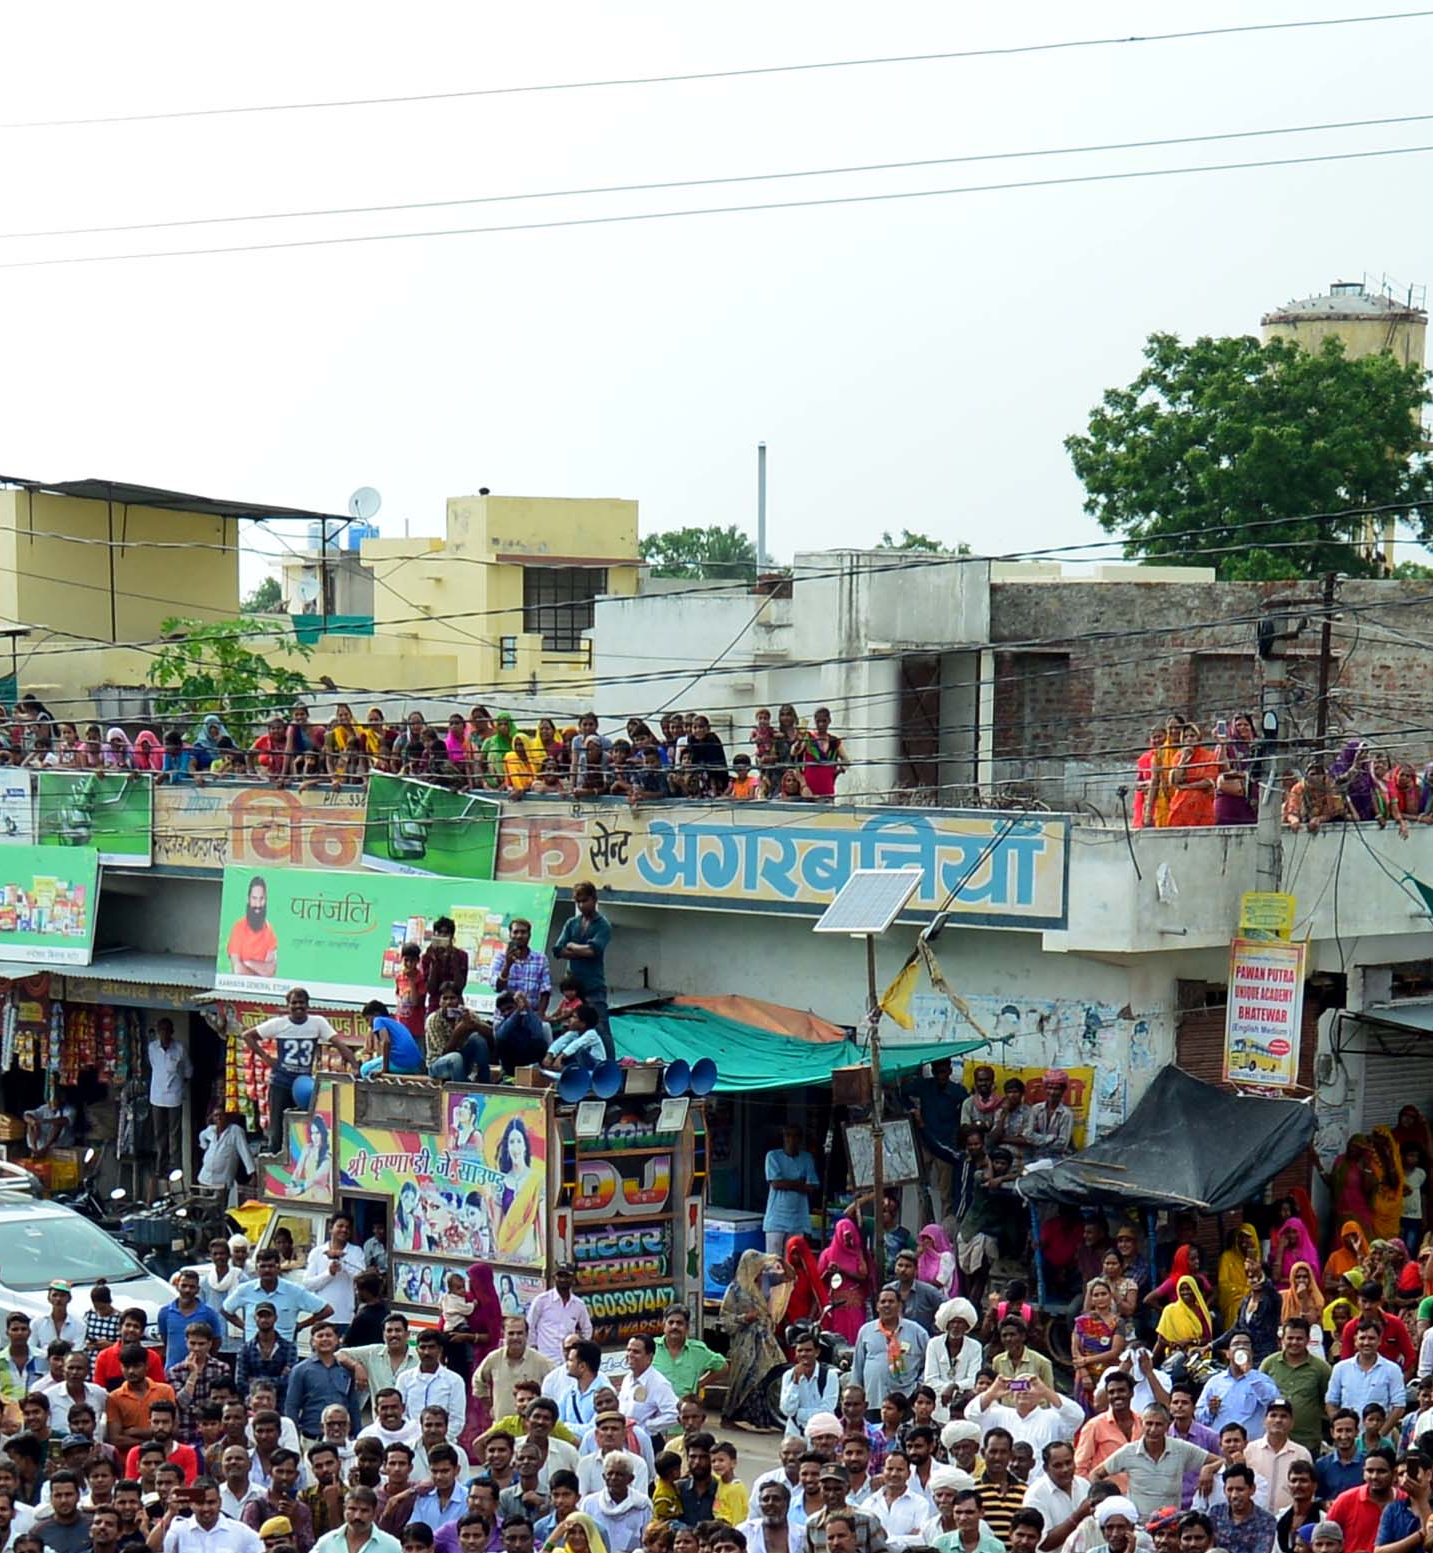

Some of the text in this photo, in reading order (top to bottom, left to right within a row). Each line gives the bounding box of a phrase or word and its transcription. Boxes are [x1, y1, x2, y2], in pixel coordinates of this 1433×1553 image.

[590, 822, 630, 872] सेन्ट
[290, 890, 373, 924] पतंजलि
[1236, 966, 1295, 983] PAWAN PUTRA
[1235, 984, 1293, 1003] UNIQUE ACADEMY
[1238, 1006, 1288, 1024] BHATEWAR
[283, 1039, 314, 1069] 23
[347, 1147, 367, 1177] श्री
[370, 1152, 411, 1181] कृष्णा
[458, 1159, 505, 1193] साउण्ड
[574, 1154, 671, 1221] DJ
[574, 1223, 664, 1258] भटेवर
